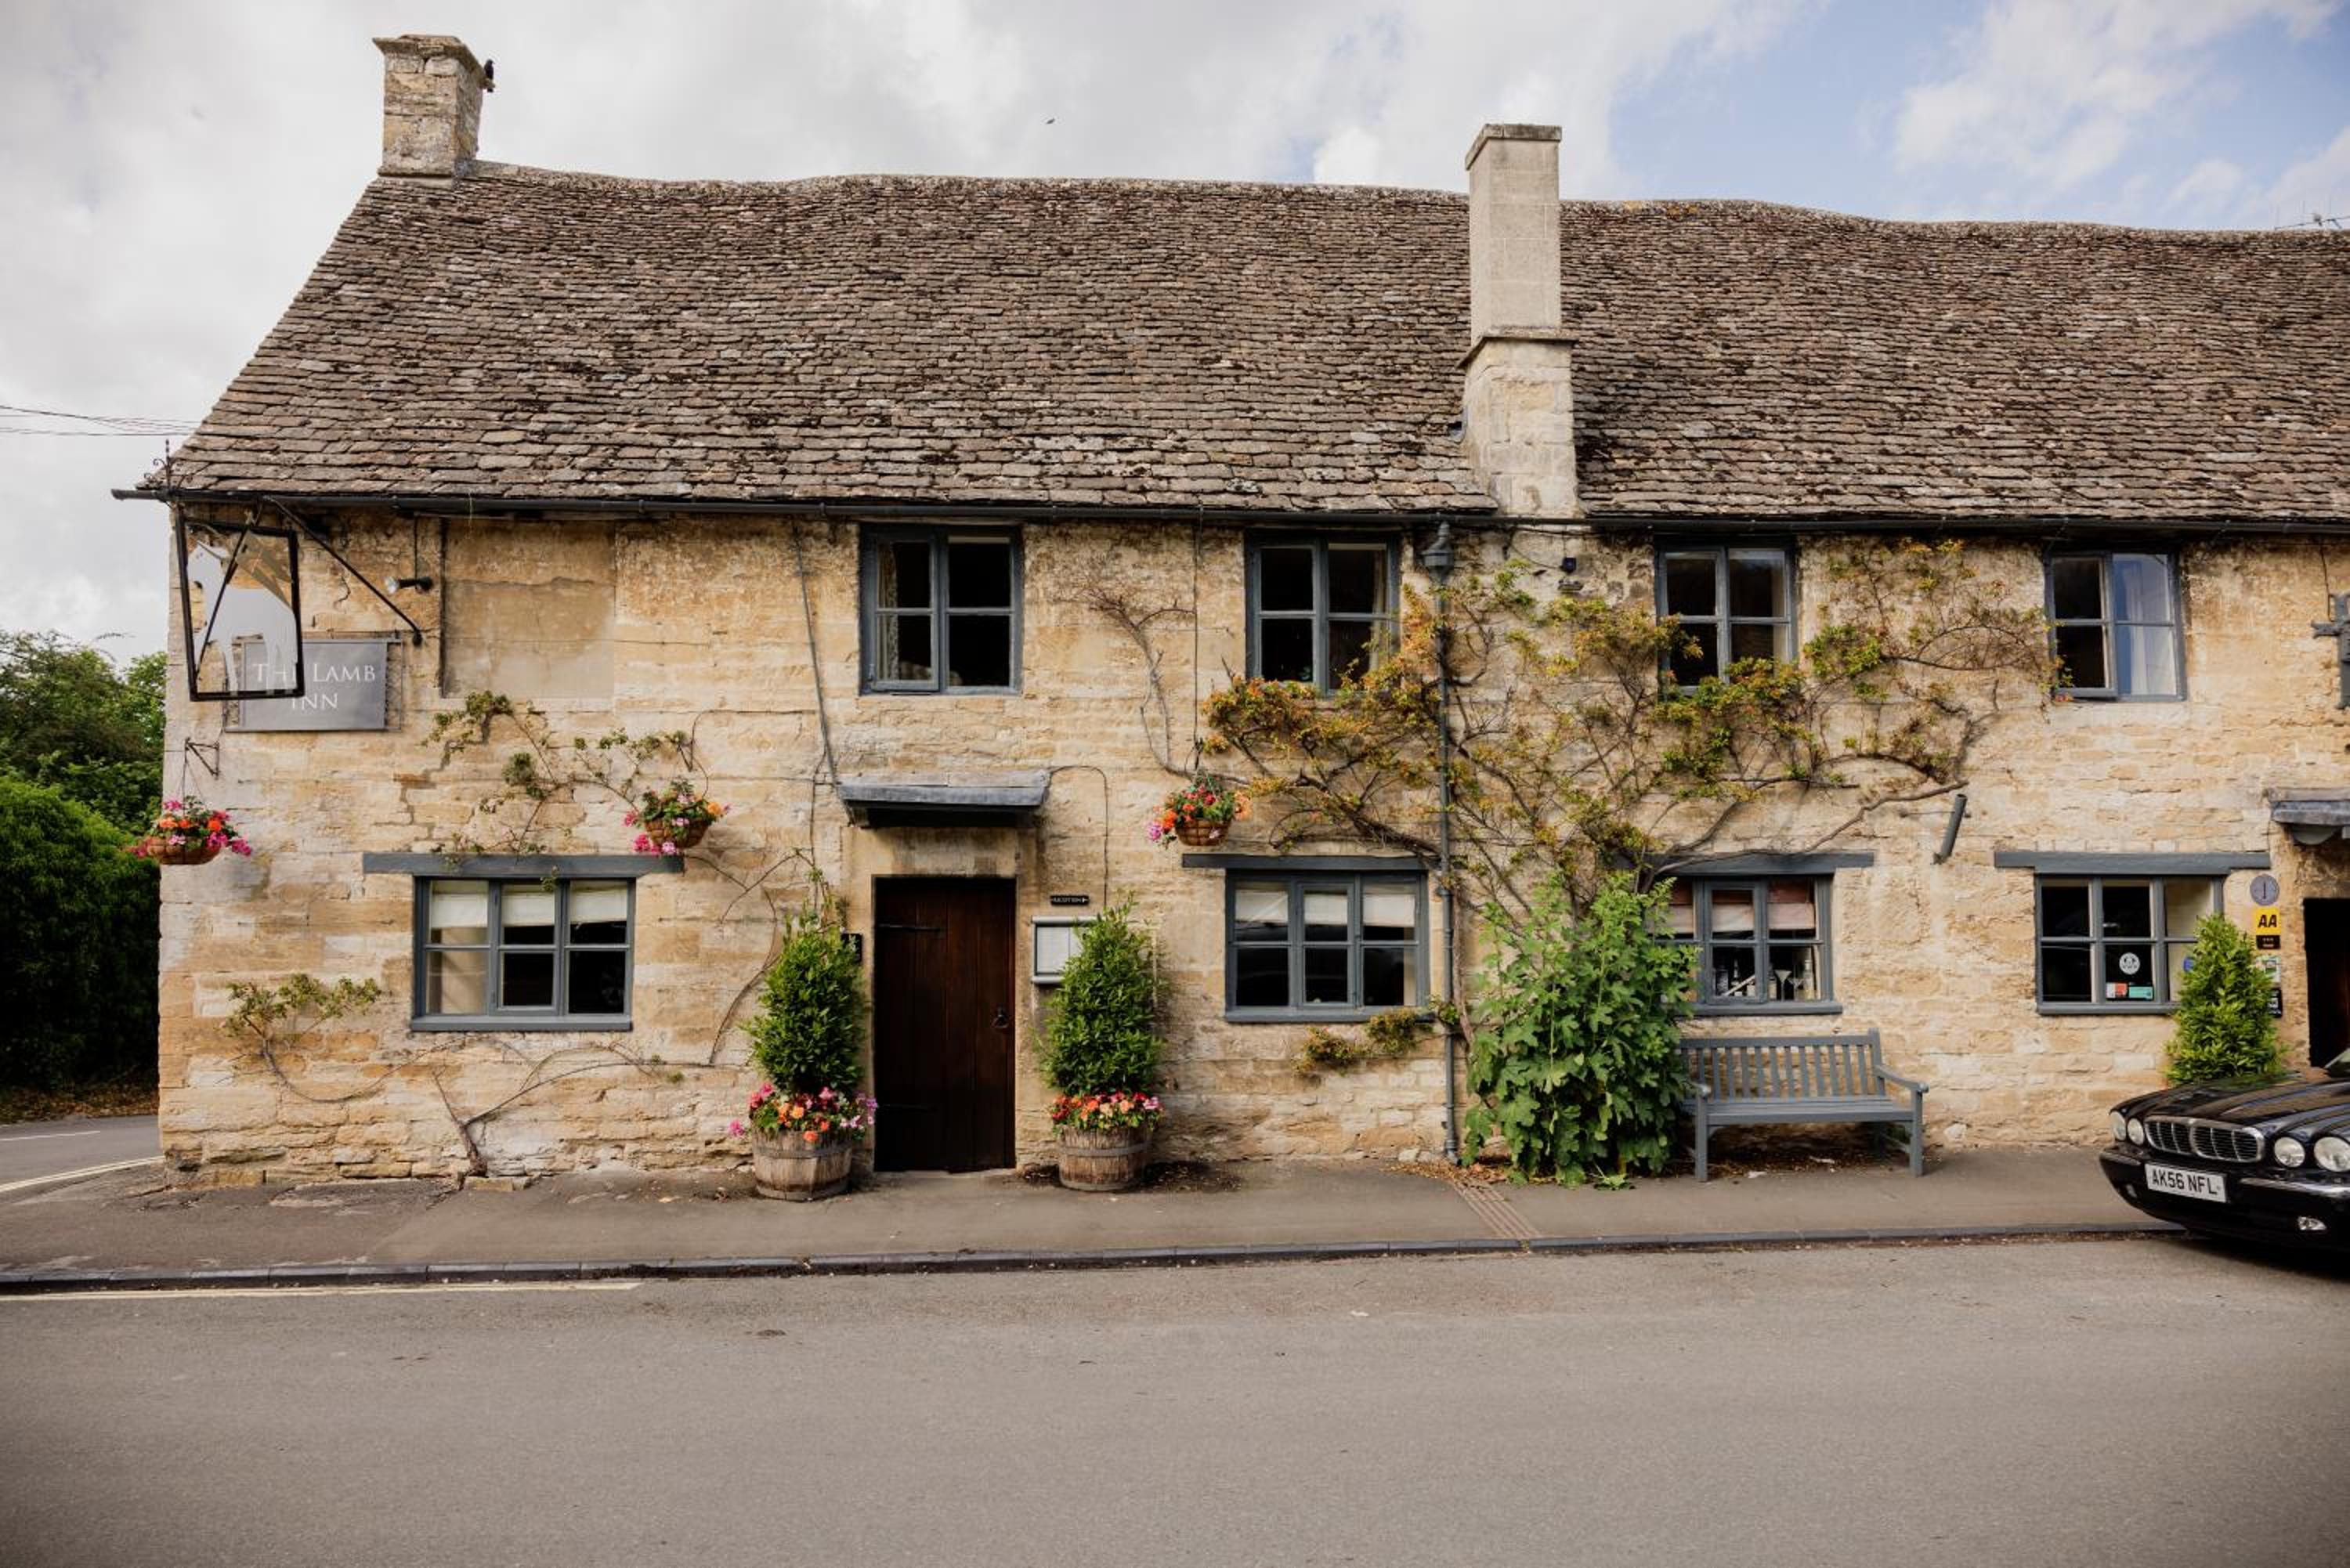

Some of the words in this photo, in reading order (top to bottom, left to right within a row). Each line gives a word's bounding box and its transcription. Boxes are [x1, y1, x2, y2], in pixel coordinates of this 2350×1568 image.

[251, 663, 298, 683] TH
[313, 663, 376, 682] LAMB
[2258, 914, 2278, 928] AA
[2152, 1169, 2185, 1190] AK56
[2187, 1175, 2218, 1195] NFL
